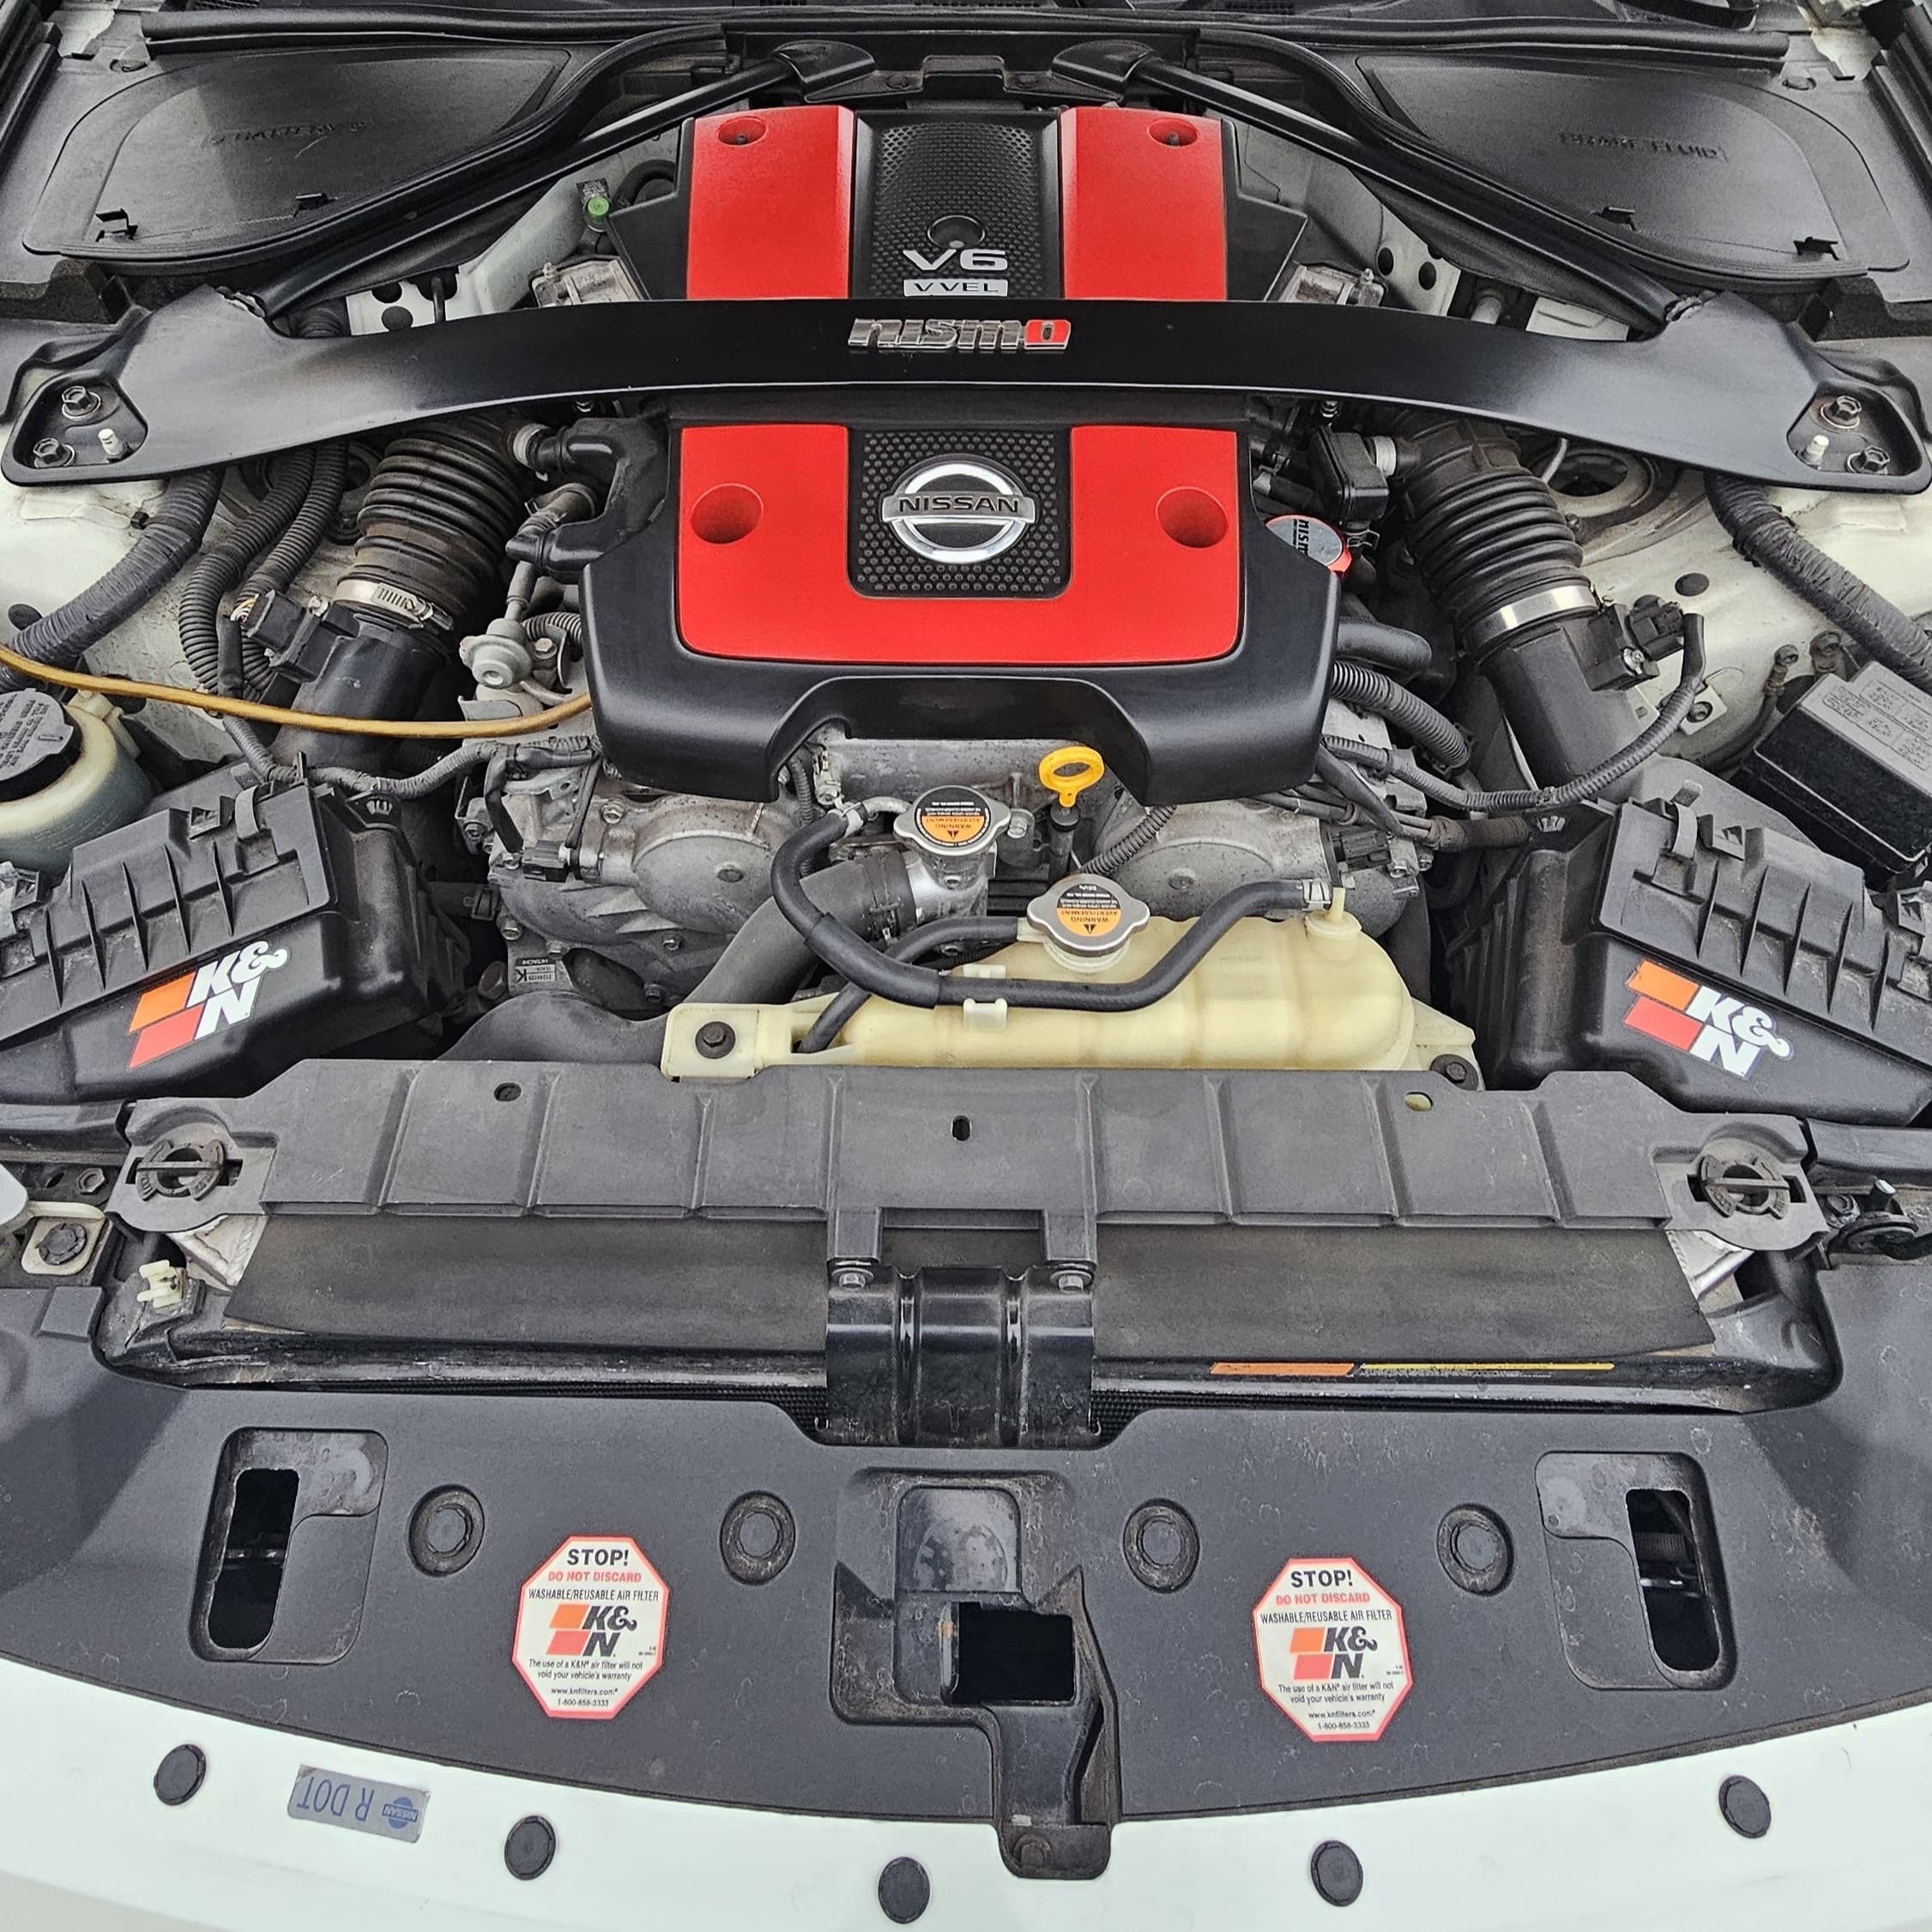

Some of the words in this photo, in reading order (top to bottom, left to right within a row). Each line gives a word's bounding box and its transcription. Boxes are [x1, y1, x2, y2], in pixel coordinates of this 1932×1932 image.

[903, 249, 1008, 271] V6
[914, 282, 999, 293] VVEL
[898, 495, 1019, 514] NISSAN
[1298, 519, 1310, 556] nism
[567, 1549, 629, 1567] STOP!
[548, 1571, 564, 1582] DO
[566, 1571, 590, 1582] NOT
[593, 1572, 642, 1583] DISCARD
[1290, 1569, 1353, 1588] STOP!
[528, 1588, 614, 1601] WASHABLE/REUSABLE
[617, 1590, 631, 1601] AIR
[633, 1591, 659, 1601] FILTER
[1276, 1594, 1291, 1605] DO
[1295, 1593, 1318, 1604] NOT
[1321, 1592, 1371, 1603] DISCARD
[1260, 1610, 1348, 1624] WASHABLE/REUSABLE
[1350, 1609, 1364, 1621] AIR
[1366, 1609, 1392, 1621] FILTER
[529, 1658, 541, 1667] The
[557, 1659, 564, 1669] of
[590, 1660, 600, 1669] air
[601, 1659, 617, 1669] filter
[618, 1660, 630, 1669] will
[631, 1661, 643, 1669] not
[538, 1669, 552, 1678] void
[553, 1671, 569, 1681] your
[571, 1669, 601, 1679] vehicle's
[601, 1672, 631, 1681] warranty
[1278, 1684, 1292, 1693] The
[1307, 1683, 1314, 1693] of
[1352, 1681, 1367, 1691] filter
[1368, 1681, 1381, 1690] will
[1290, 1694, 1305, 1704] void
[1307, 1695, 1322, 1706] your
[1324, 1694, 1355, 1702] vehicle's
[1355, 1693, 1386, 1702] warranty
[296, 1777, 352, 1817] DOT
[355, 1787, 375, 1821] R
[383, 1805, 418, 1821] NISSAN
